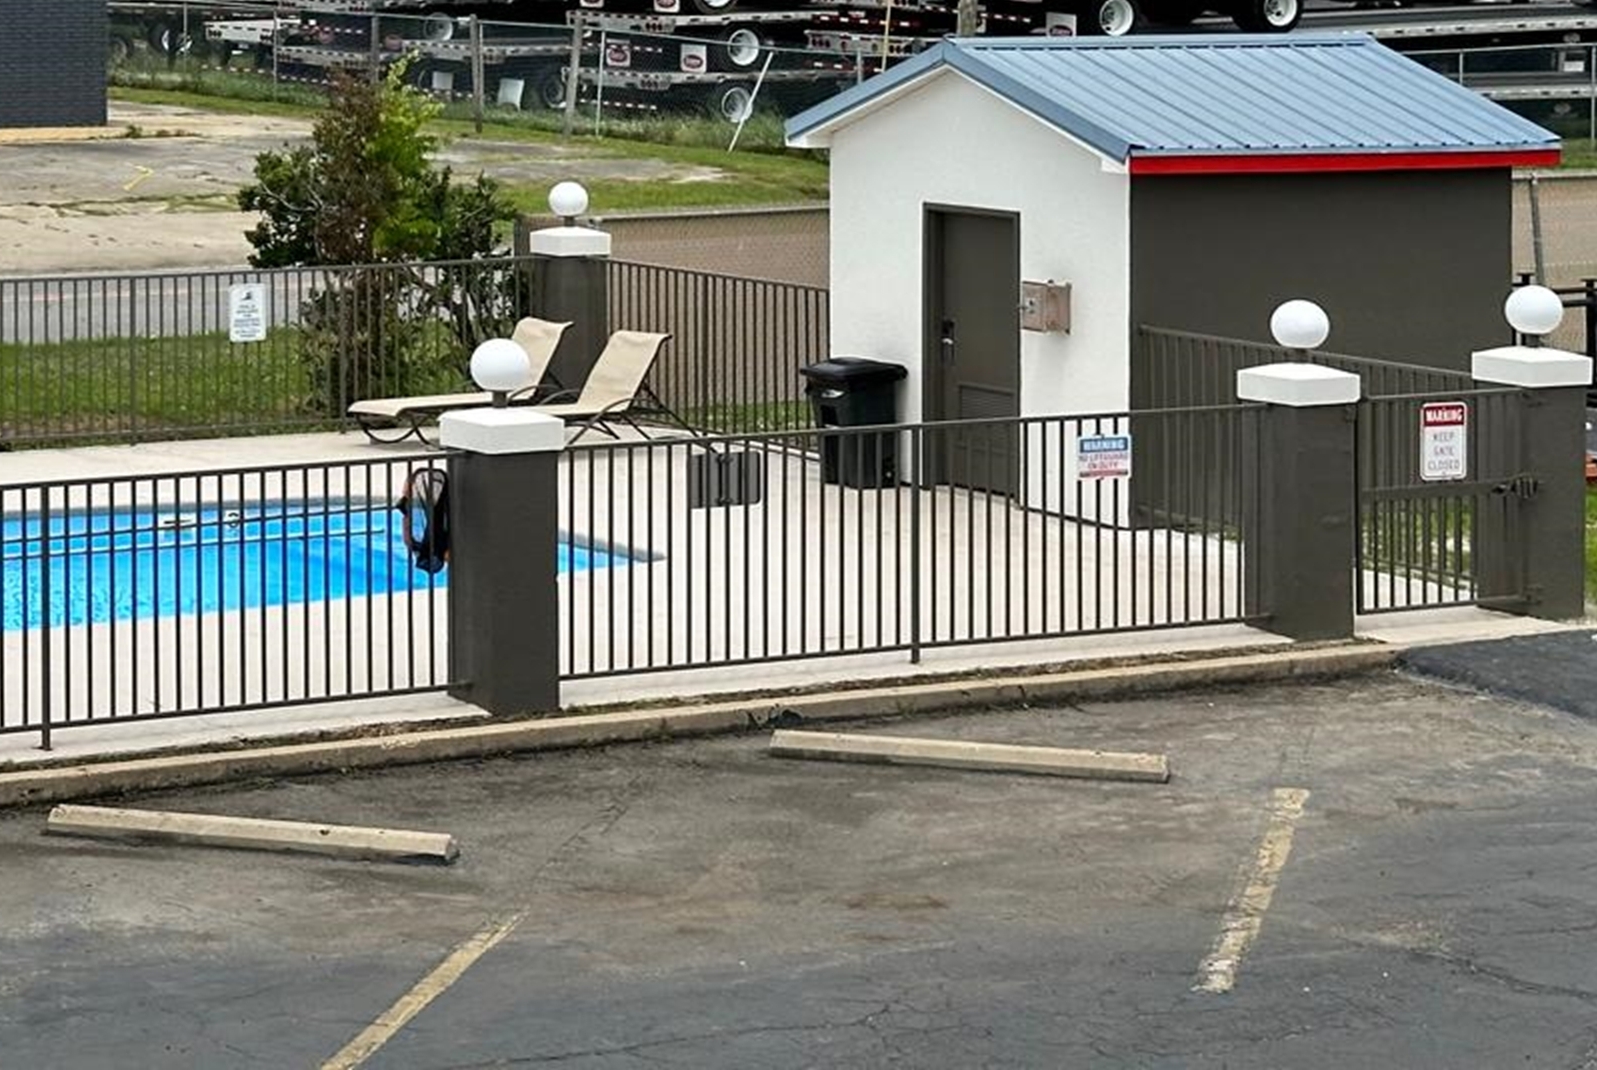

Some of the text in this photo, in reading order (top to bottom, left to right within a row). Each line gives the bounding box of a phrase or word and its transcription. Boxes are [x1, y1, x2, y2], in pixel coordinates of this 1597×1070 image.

[1425, 408, 1463, 422] WARNING
[1433, 431, 1454, 441] KEEP
[1083, 438, 1126, 451] WARNING
[1434, 445, 1454, 456] GATE
[1078, 453, 1128, 462] NO LIFEGUARD
[1427, 459, 1460, 470] CLOSED
